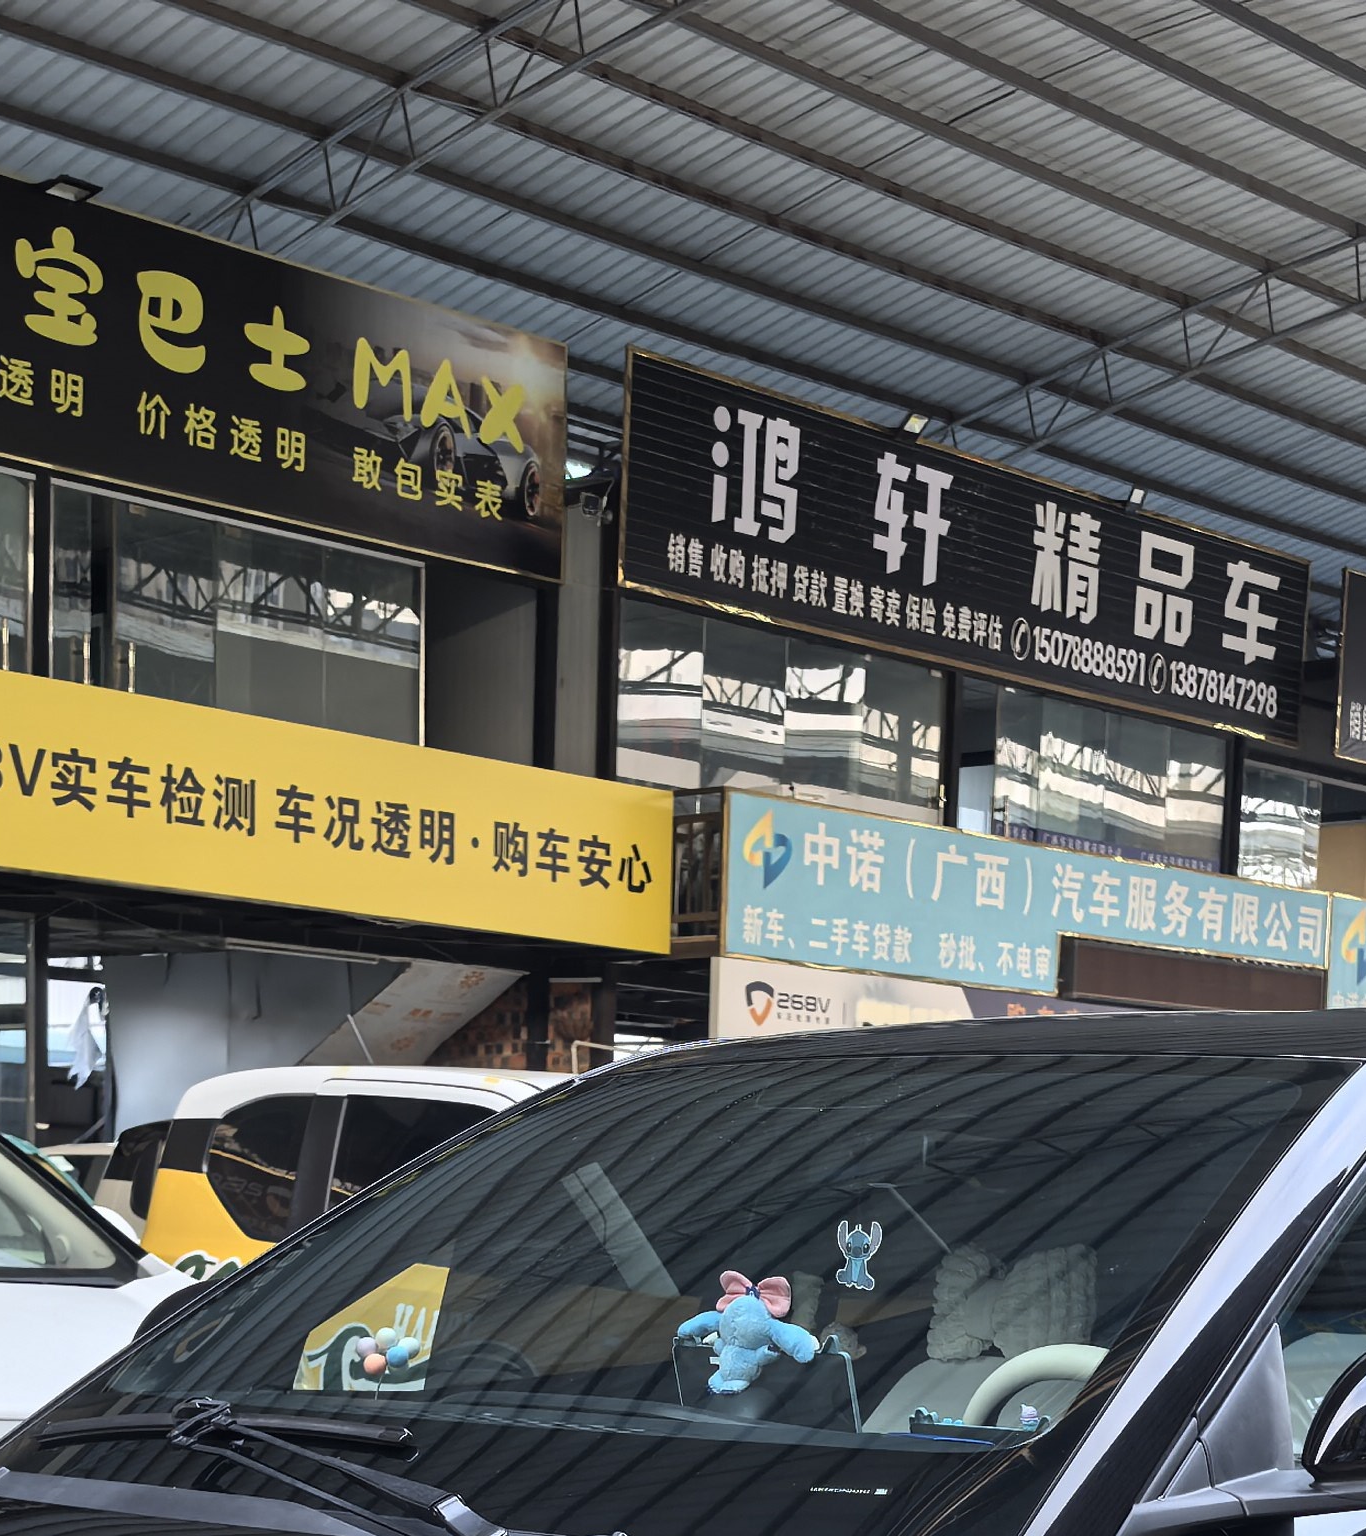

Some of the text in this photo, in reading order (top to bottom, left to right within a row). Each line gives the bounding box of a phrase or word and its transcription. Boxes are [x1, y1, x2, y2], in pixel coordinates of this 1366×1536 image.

[138, 391, 307, 472] 价格透明
[352, 447, 505, 522] 敢包实表
[352, 338, 525, 453] MAX
[710, 406, 1281, 665] 鸿轩精品车
[667, 532, 1278, 719] 销售 收购 抵押 贷款 置换 寄卖 保险 免费评估 15078888591 13878147298
[776, 992, 831, 1014] 268V
